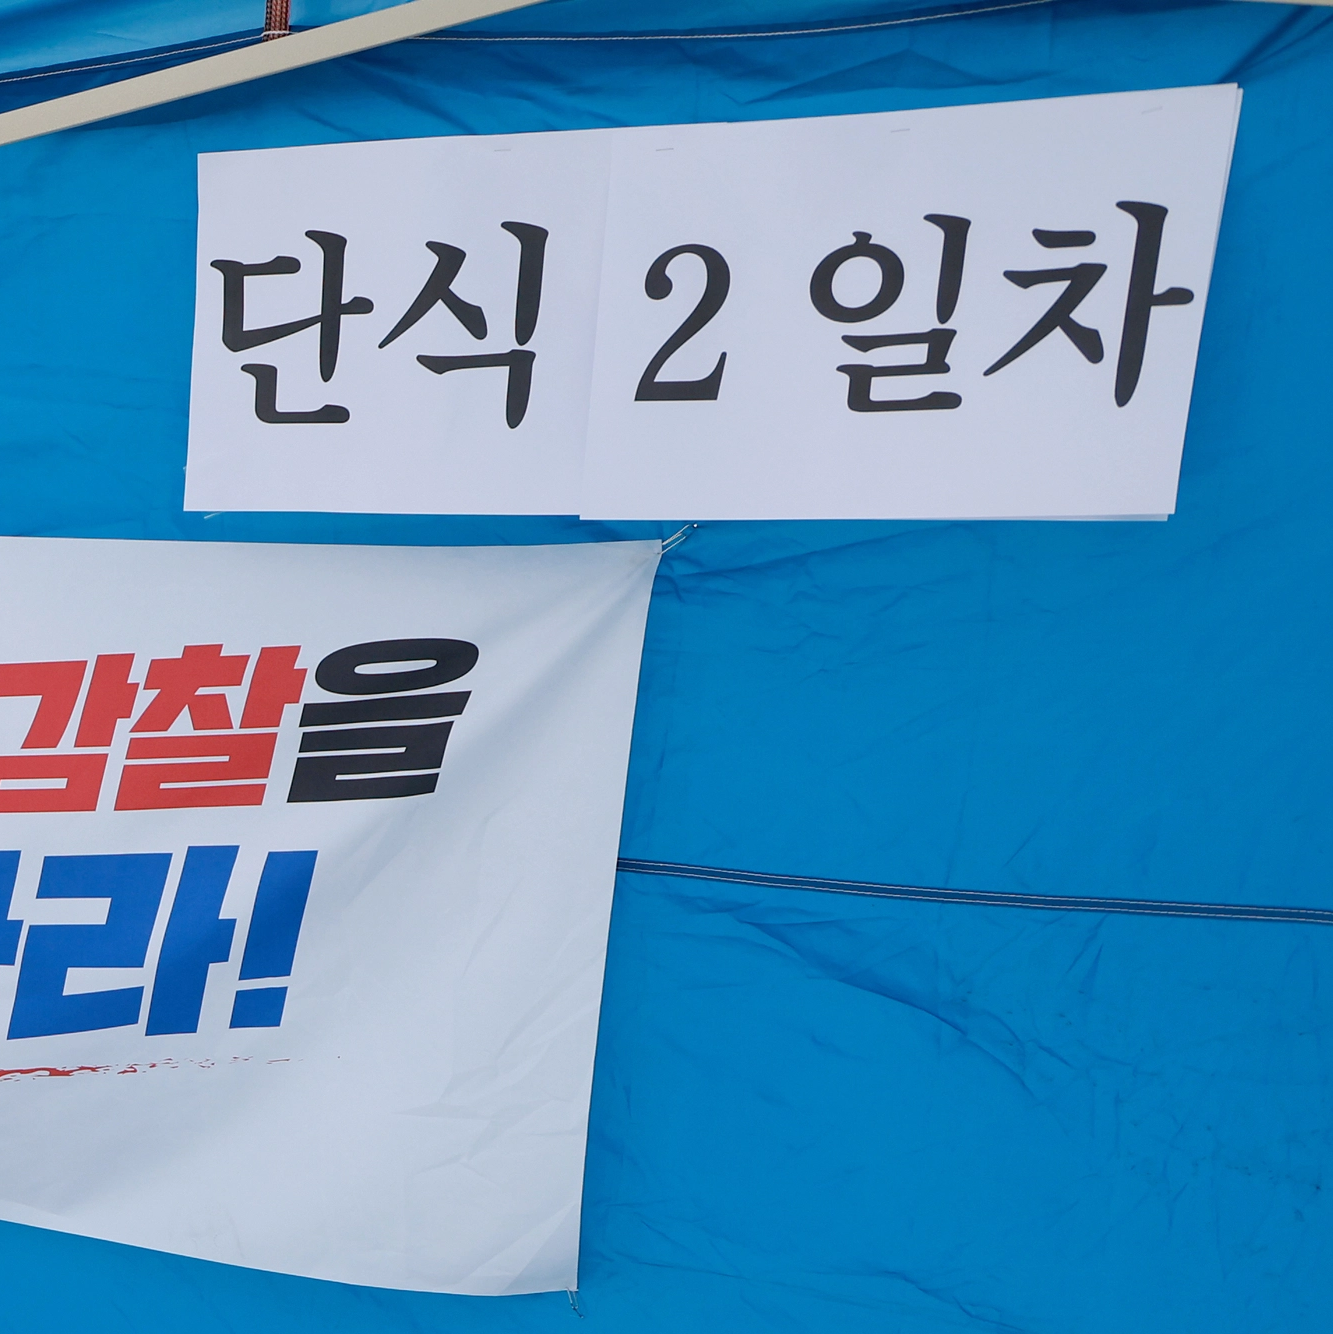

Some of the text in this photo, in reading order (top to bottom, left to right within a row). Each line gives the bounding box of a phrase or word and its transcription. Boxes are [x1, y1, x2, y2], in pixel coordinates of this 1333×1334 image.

[209, 201, 1194, 430] 단식 2 일차
